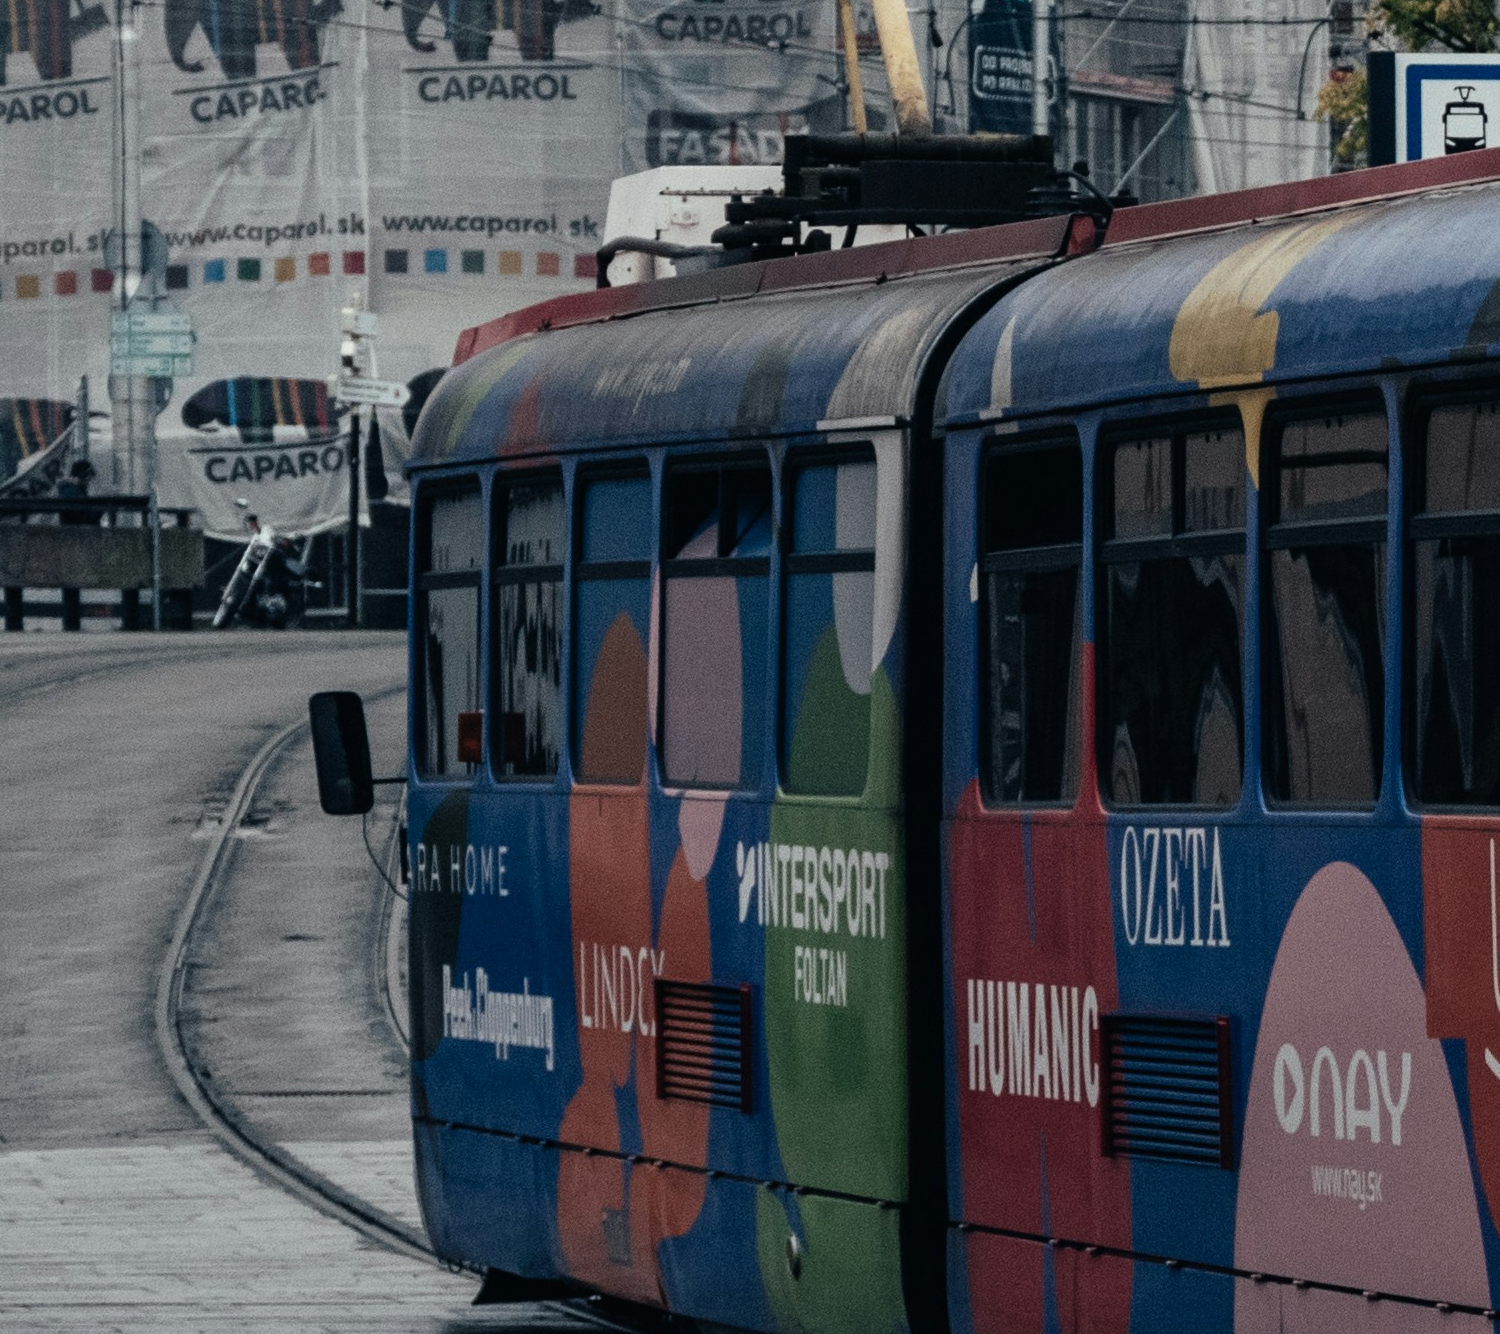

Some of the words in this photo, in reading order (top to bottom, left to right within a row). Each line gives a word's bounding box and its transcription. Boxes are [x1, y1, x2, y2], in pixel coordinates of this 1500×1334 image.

[418, 73, 577, 104] CAPAROL
[383, 211, 599, 241] www.caparol.sk
[450, 842, 511, 898] HOME
[756, 843, 890, 940] INTERSPORT
[1120, 826, 1231, 947] OZETA
[793, 945, 848, 1008] FOLTAN
[967, 978, 1100, 1108] HUMANIC
[1311, 1164, 1384, 1211] www.nay.sk
